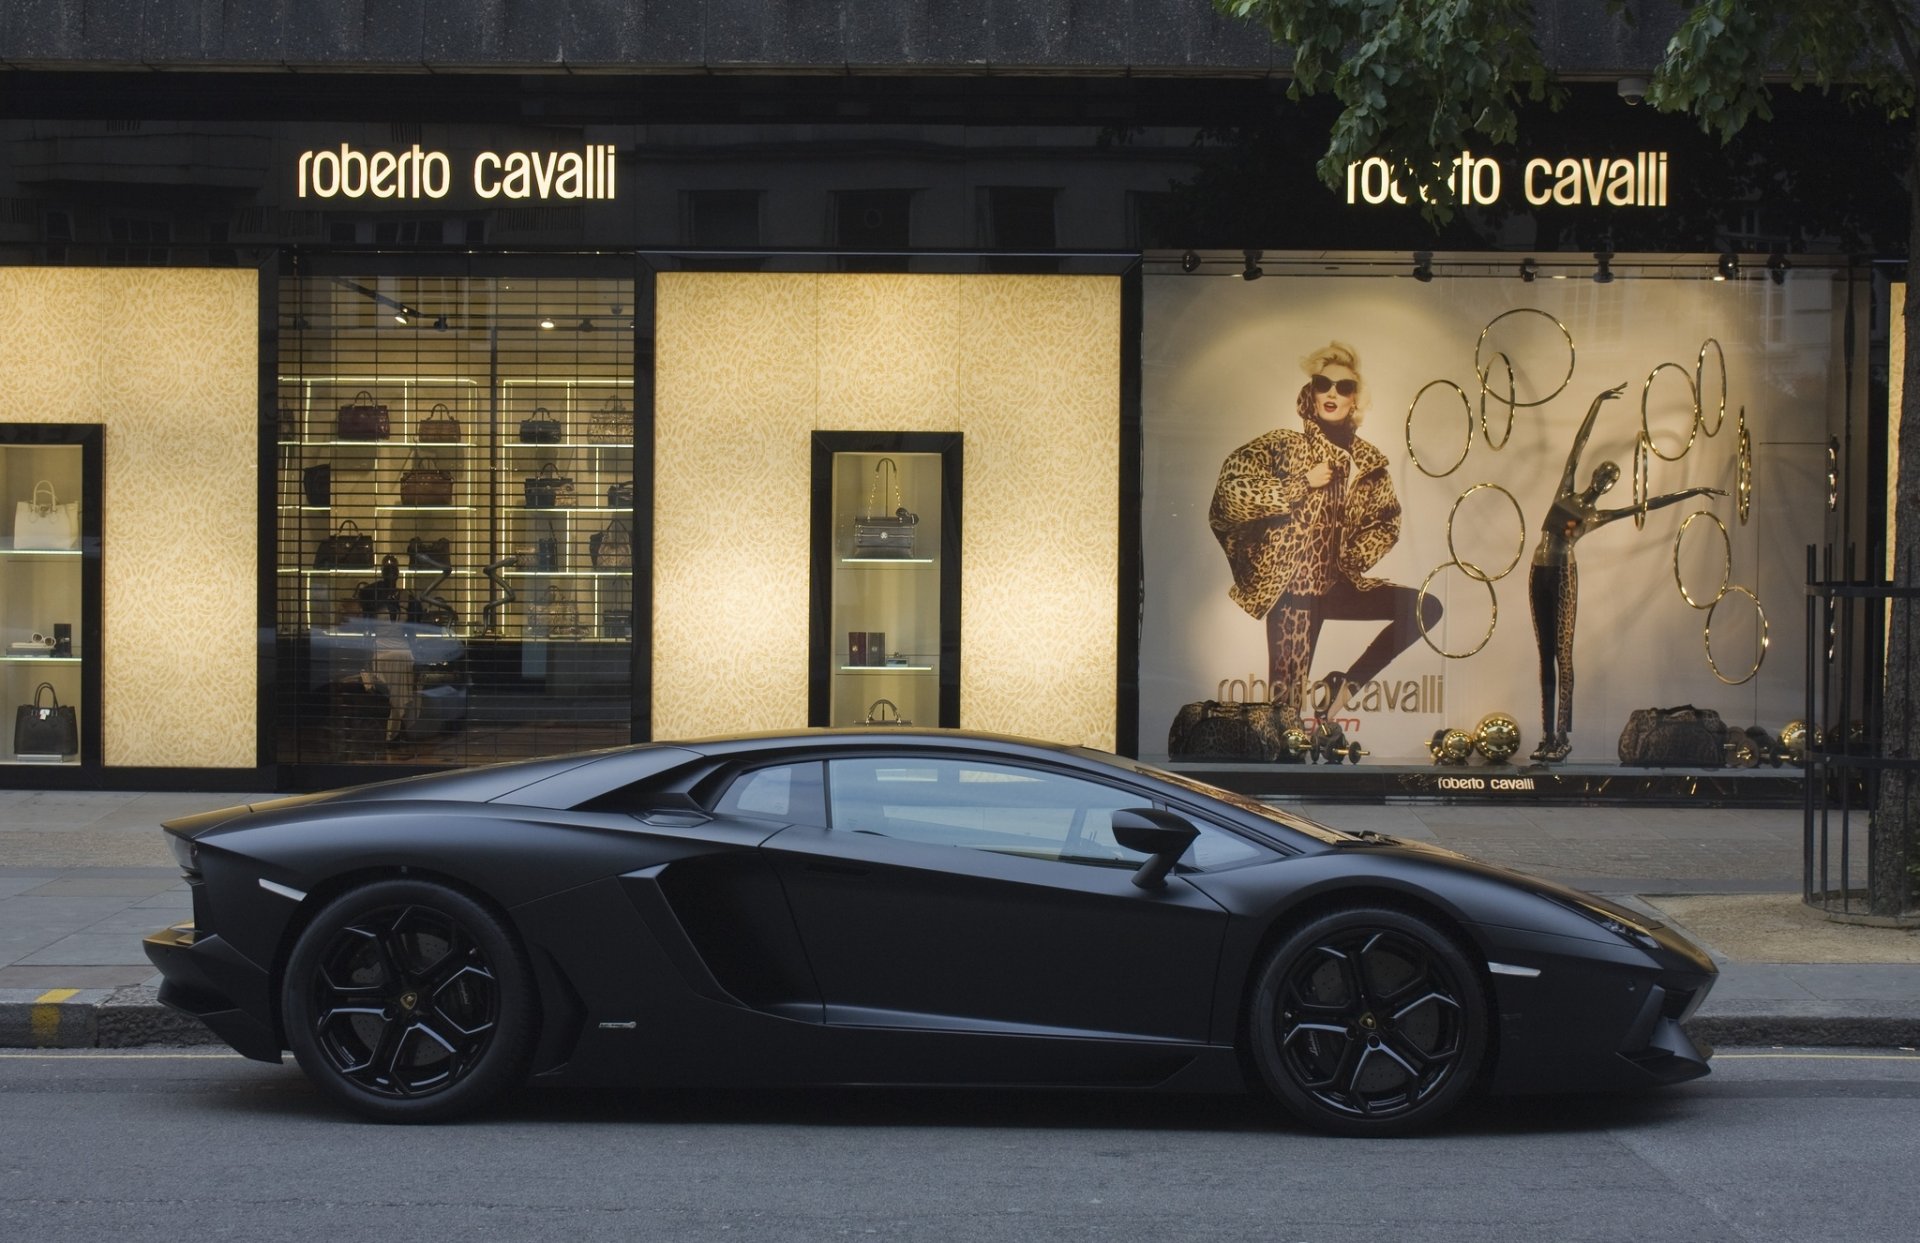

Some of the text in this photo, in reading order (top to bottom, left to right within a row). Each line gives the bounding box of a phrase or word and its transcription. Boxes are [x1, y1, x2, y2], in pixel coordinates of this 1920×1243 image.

[298, 143, 616, 200] roberto cavalli
[1346, 150, 1668, 207] rorto cavalli
[1343, 674, 1444, 714] cavalli
[1438, 776, 1535, 790] roberto cavalli
